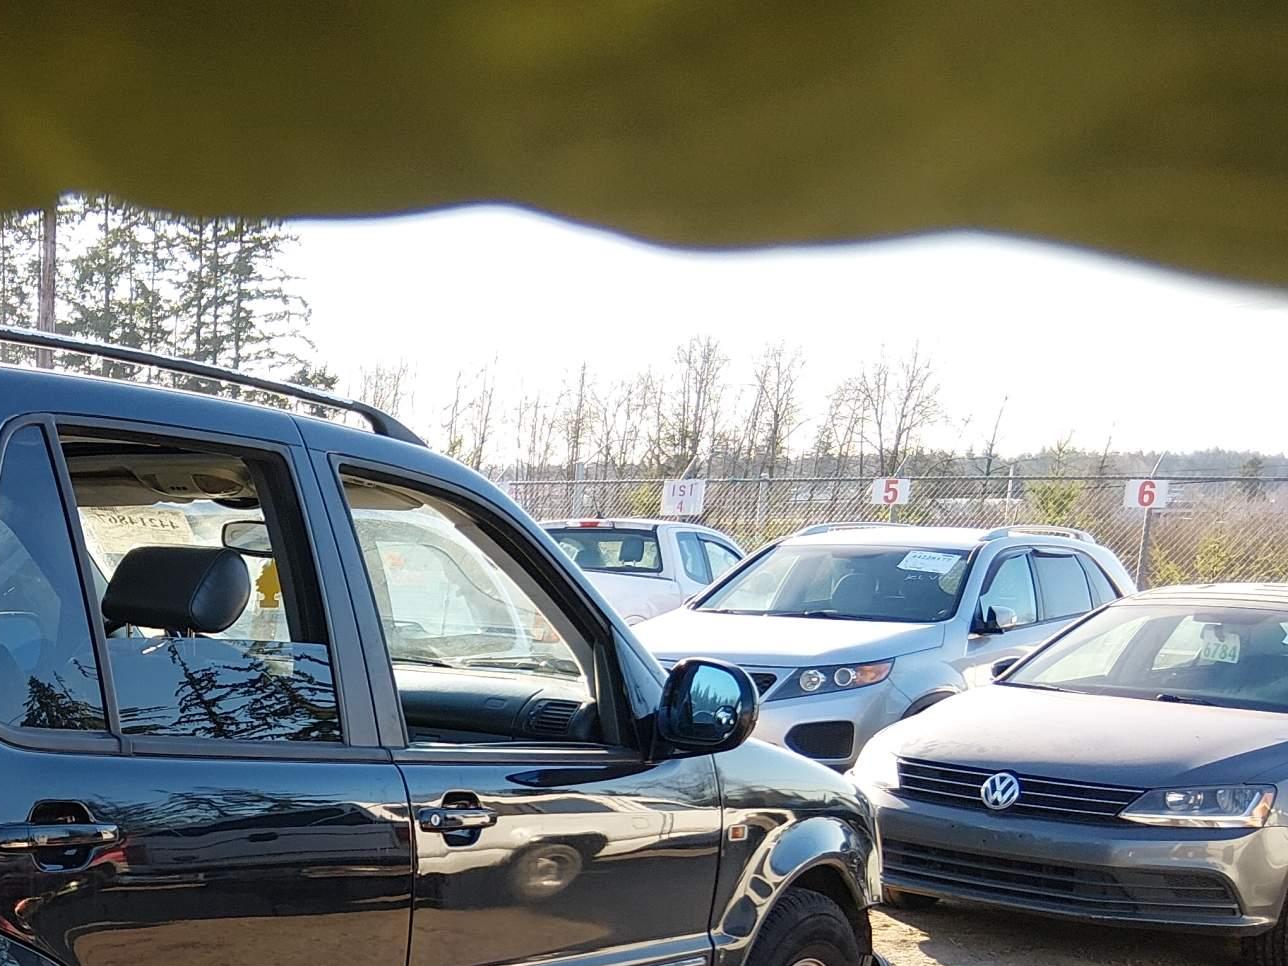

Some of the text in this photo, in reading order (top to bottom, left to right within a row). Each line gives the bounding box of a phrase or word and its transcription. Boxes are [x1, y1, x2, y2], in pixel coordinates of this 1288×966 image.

[883, 479, 899, 504] 5
[1137, 480, 1156, 507] 6
[676, 500, 684, 513] 4
[1203, 642, 1238, 661] 6784
